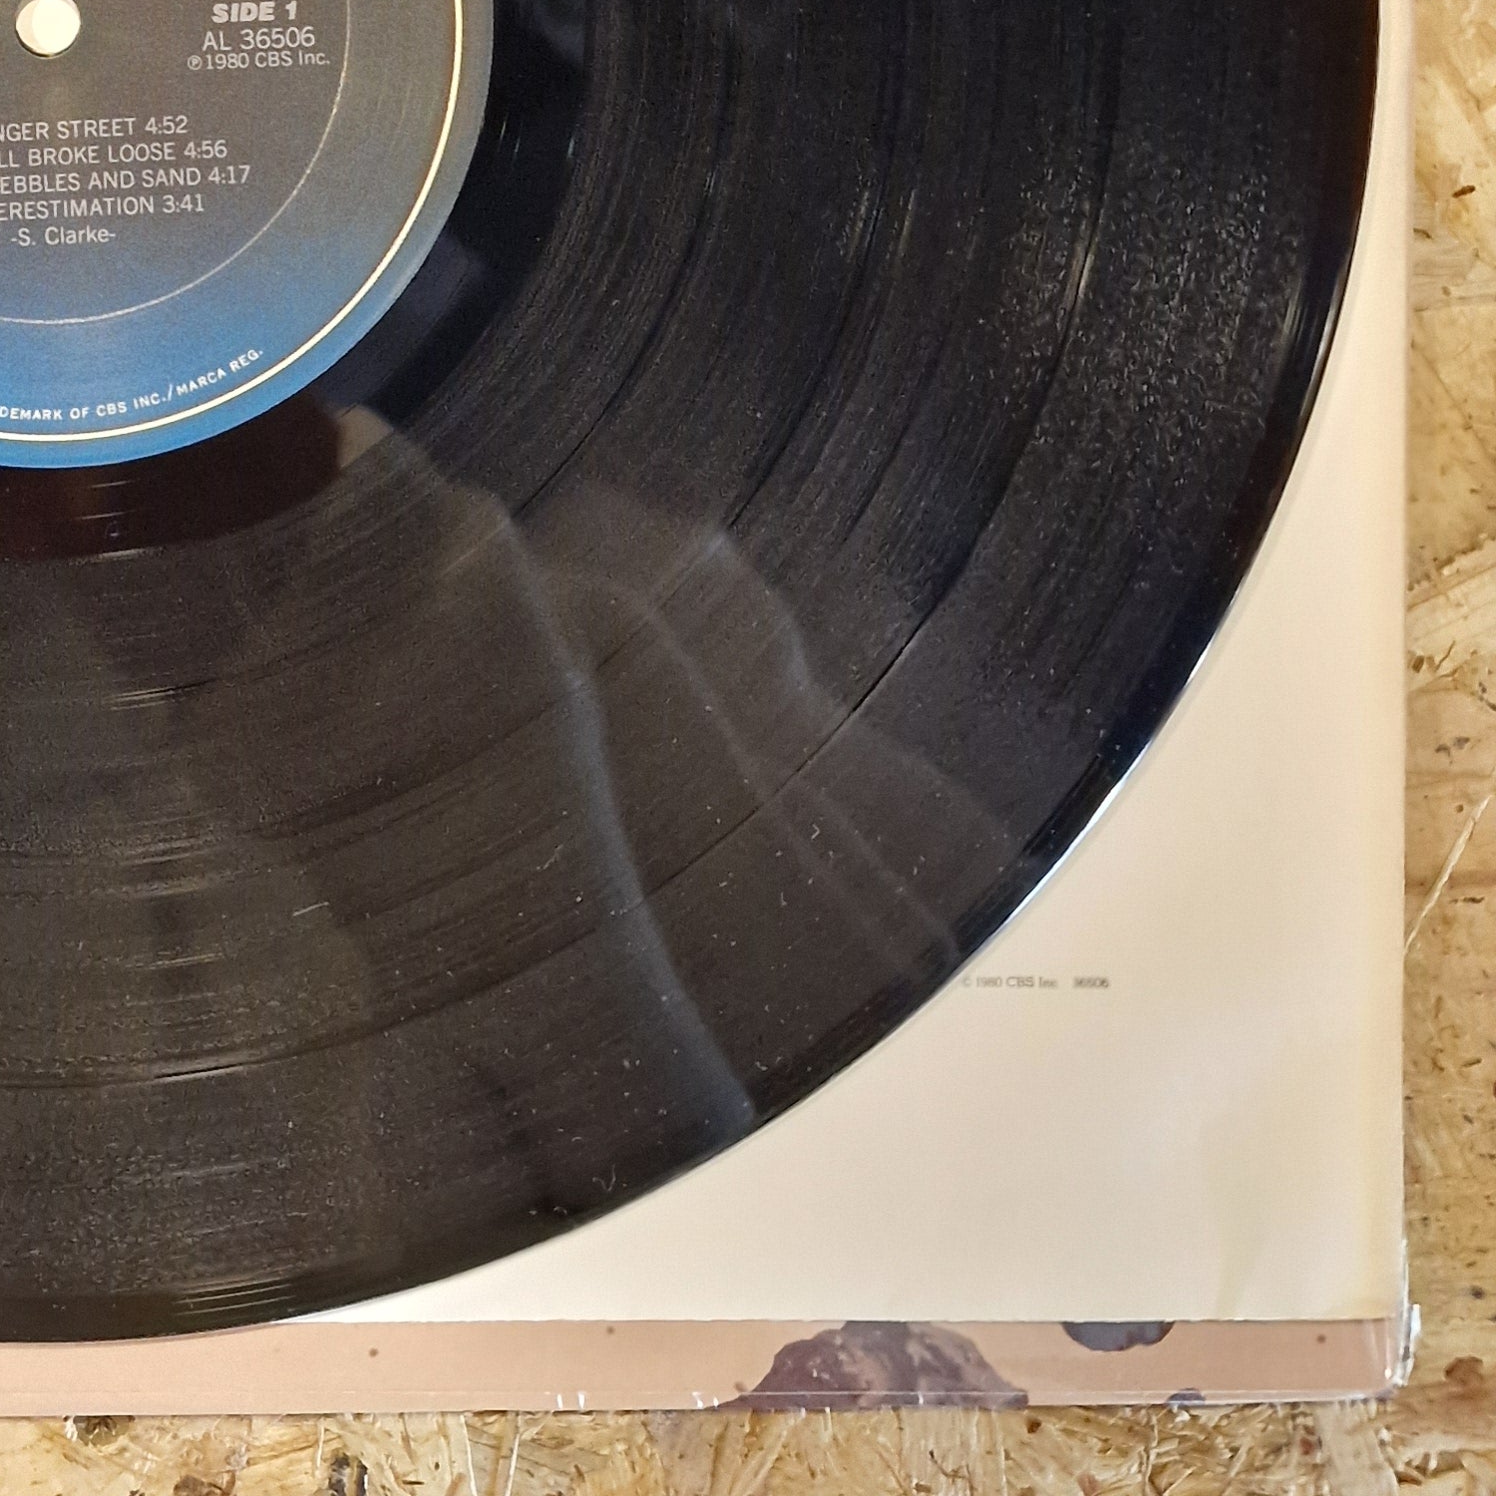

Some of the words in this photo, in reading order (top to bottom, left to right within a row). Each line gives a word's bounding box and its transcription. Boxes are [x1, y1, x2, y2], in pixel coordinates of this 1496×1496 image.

[211, 1, 276, 23] SIDE
[285, 0, 298, 21] 1
[202, 31, 232, 51] AL
[239, 25, 316, 50] 36506
[255, 51, 292, 68] CBS
[298, 49, 331, 66] Inc.
[57, 117, 137, 140] STREET
[145, 115, 189, 135] 4:52
[28, 145, 101, 167] BROKE
[108, 141, 177, 163] LOOSE
[184, 139, 229, 160] 4:56
[88, 170, 136, 191] AND
[142, 166, 202, 189] SAND
[208, 164, 251, 186] 4:17
[162, 193, 205, 215] 3:41
[10, 227, 38, 247] -S.
[44, 224, 117, 246] Clarke-
[69, 406, 91, 421] OF
[96, 401, 129, 417] CBS
[228, 348, 265, 373] REG.
[1006, 974, 1035, 989] CBS
